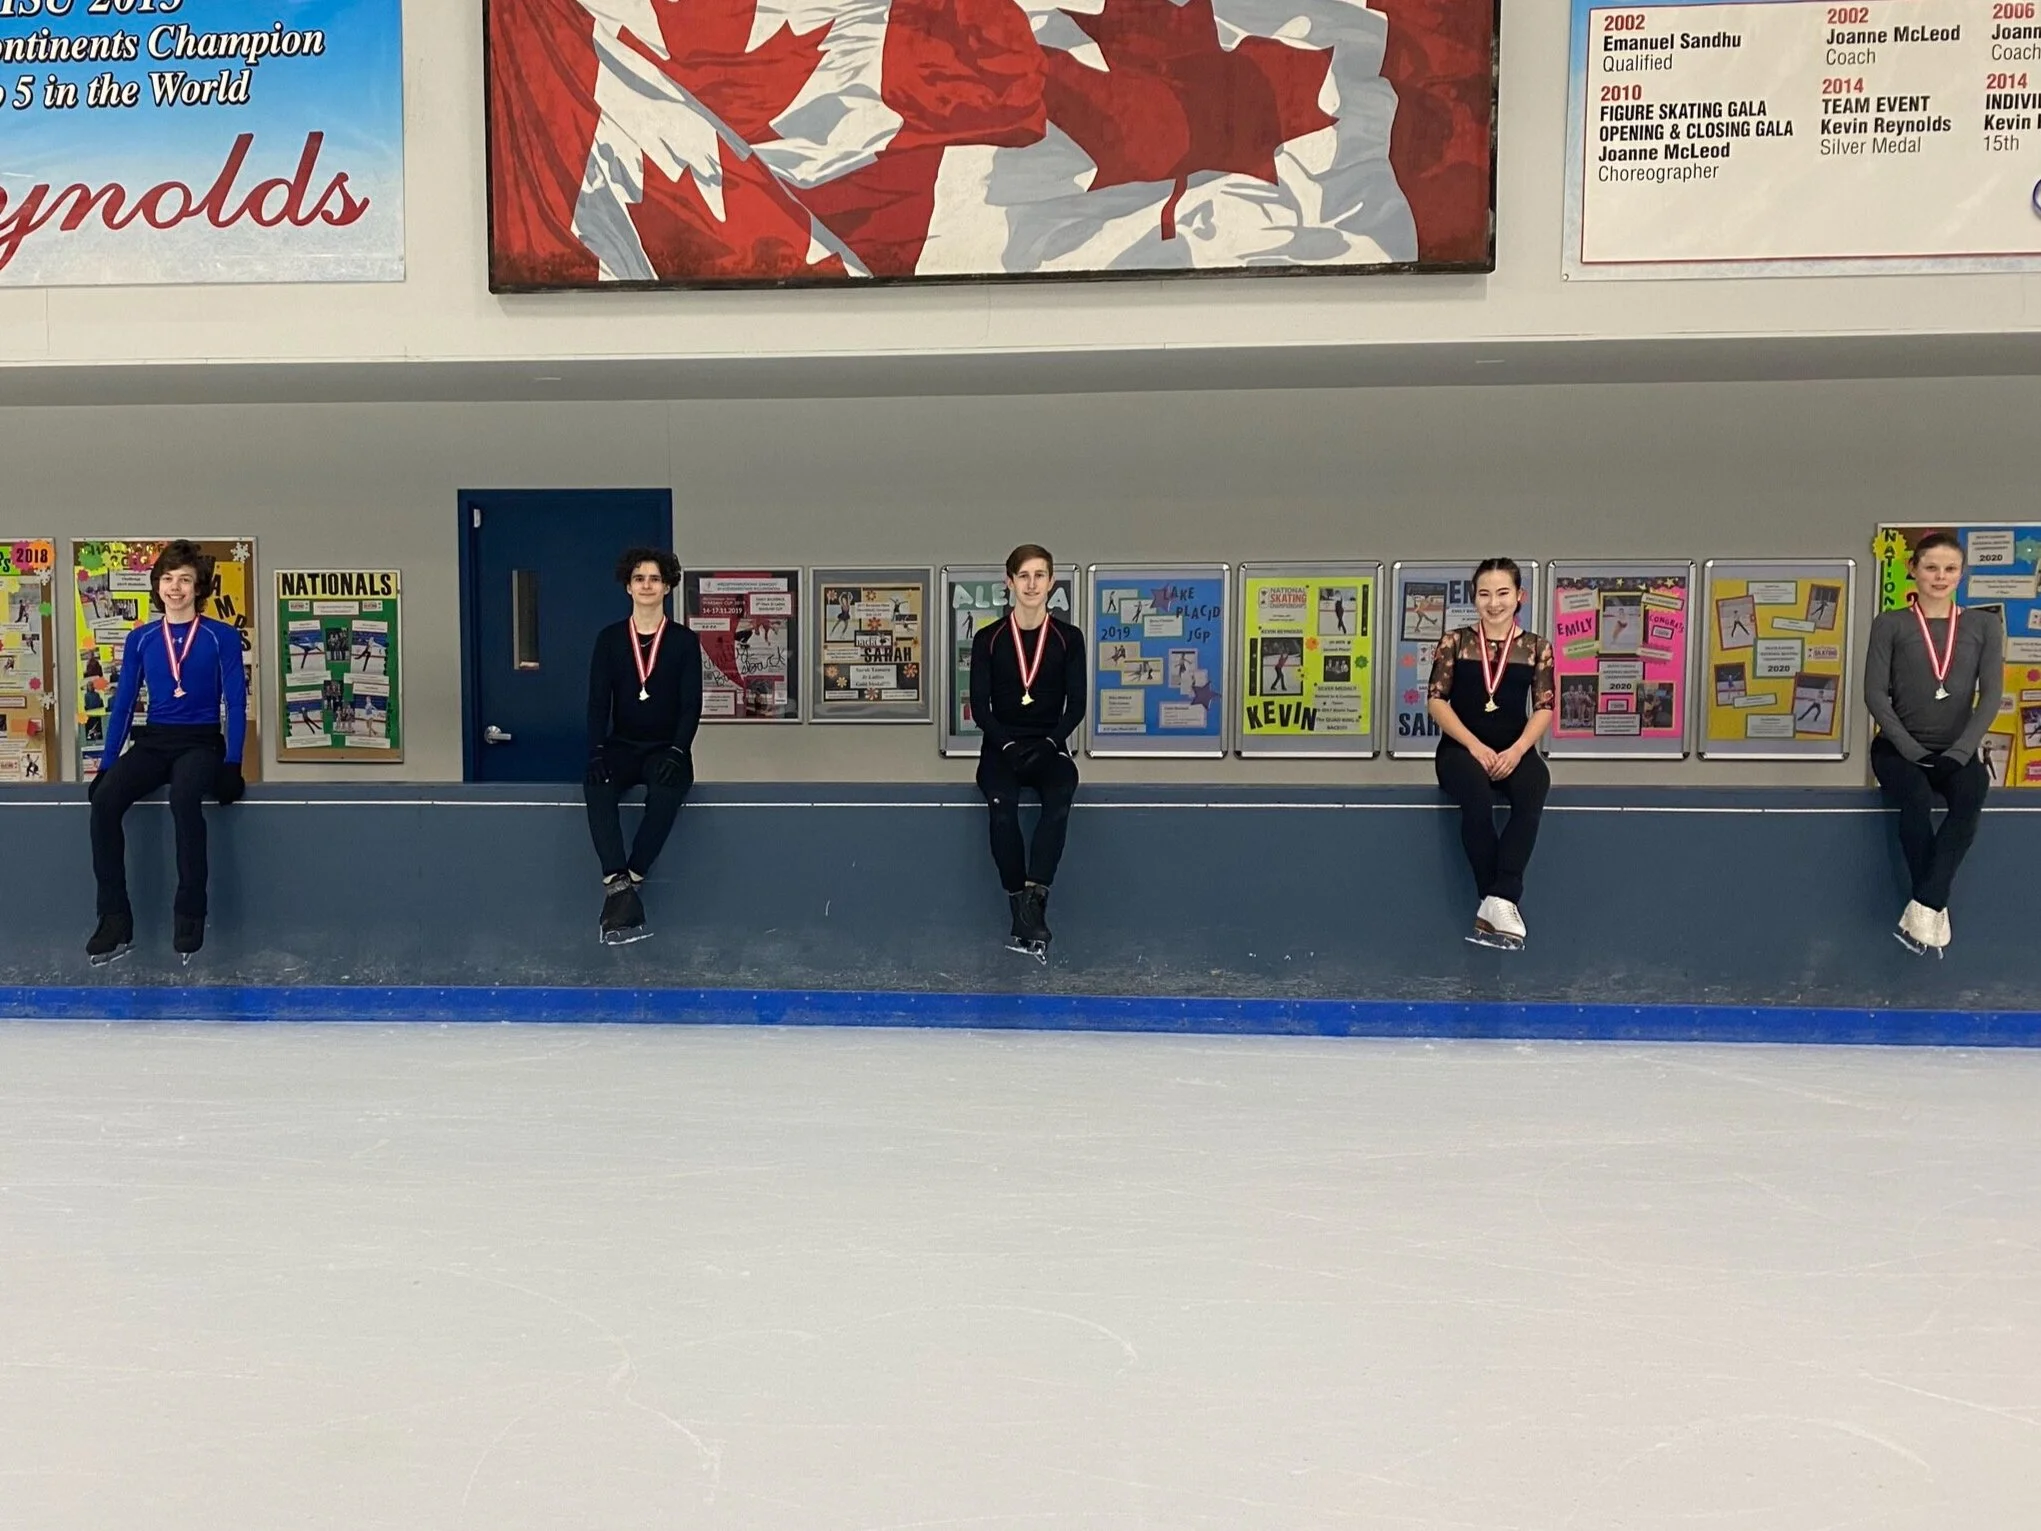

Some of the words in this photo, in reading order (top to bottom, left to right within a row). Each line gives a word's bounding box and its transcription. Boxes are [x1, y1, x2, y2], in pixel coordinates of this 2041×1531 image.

[1827, 7, 1870, 25] 2002
[1993, 3, 2035, 20] 2006
[1604, 14, 1646, 32] 2002
[0, 28, 140, 64] ntinents
[148, 22, 326, 65] Champion
[1603, 34, 1675, 51] Emanuel
[1680, 32, 1742, 49] Sandhu
[1826, 29, 1888, 45] Joanne
[1894, 25, 1961, 42] McLeod
[1826, 48, 1876, 66] Coach
[1992, 44, 2041, 61] Coach
[1603, 54, 1674, 73] Qualified
[13, 75, 36, 110] 5
[44, 74, 79, 109] in
[87, 72, 141, 108] the
[148, 68, 253, 107] World
[1822, 78, 1865, 95] 2014
[1986, 73, 2028, 90] 2014
[1600, 84, 1643, 102] 2010
[1600, 104, 1655, 121] FIGURE
[1659, 102, 1723, 119] SKATING
[1728, 100, 1767, 117] GALA
[1822, 98, 1871, 115] TEAM
[1876, 96, 1931, 113] EVENT
[1599, 124, 1665, 142] OPENING
[1669, 123, 1681, 140] &
[1686, 122, 1751, 139] CLOSING
[1755, 120, 1794, 137] GALA
[1820, 118, 1868, 135] Kevin
[1874, 115, 1952, 136] Reynolds
[1984, 114, 2032, 131] Kevin
[1598, 146, 1658, 162] Joanne
[1664, 142, 1731, 160] McLeod
[1820, 138, 1867, 155] Silver
[1872, 136, 1922, 154] Medal
[1983, 135, 2020, 151] 15th
[1598, 163, 1720, 184] Choreographer
[0, 131, 371, 270] ynolds
[16, 548, 48, 563] 2018
[1979, 554, 2003, 562] 2020
[282, 573, 392, 596] NATIONALS
[1164, 586, 1195, 601] LAKE
[1270, 594, 1307, 603] SKATING
[1176, 604, 1221, 621] PLACID
[1101, 626, 1131, 641] 2019
[1187, 627, 1211, 643] JGP
[1557, 617, 1593, 637] EMILY
[864, 647, 912, 663] SARAH
[1246, 701, 1317, 731] KEVIN
